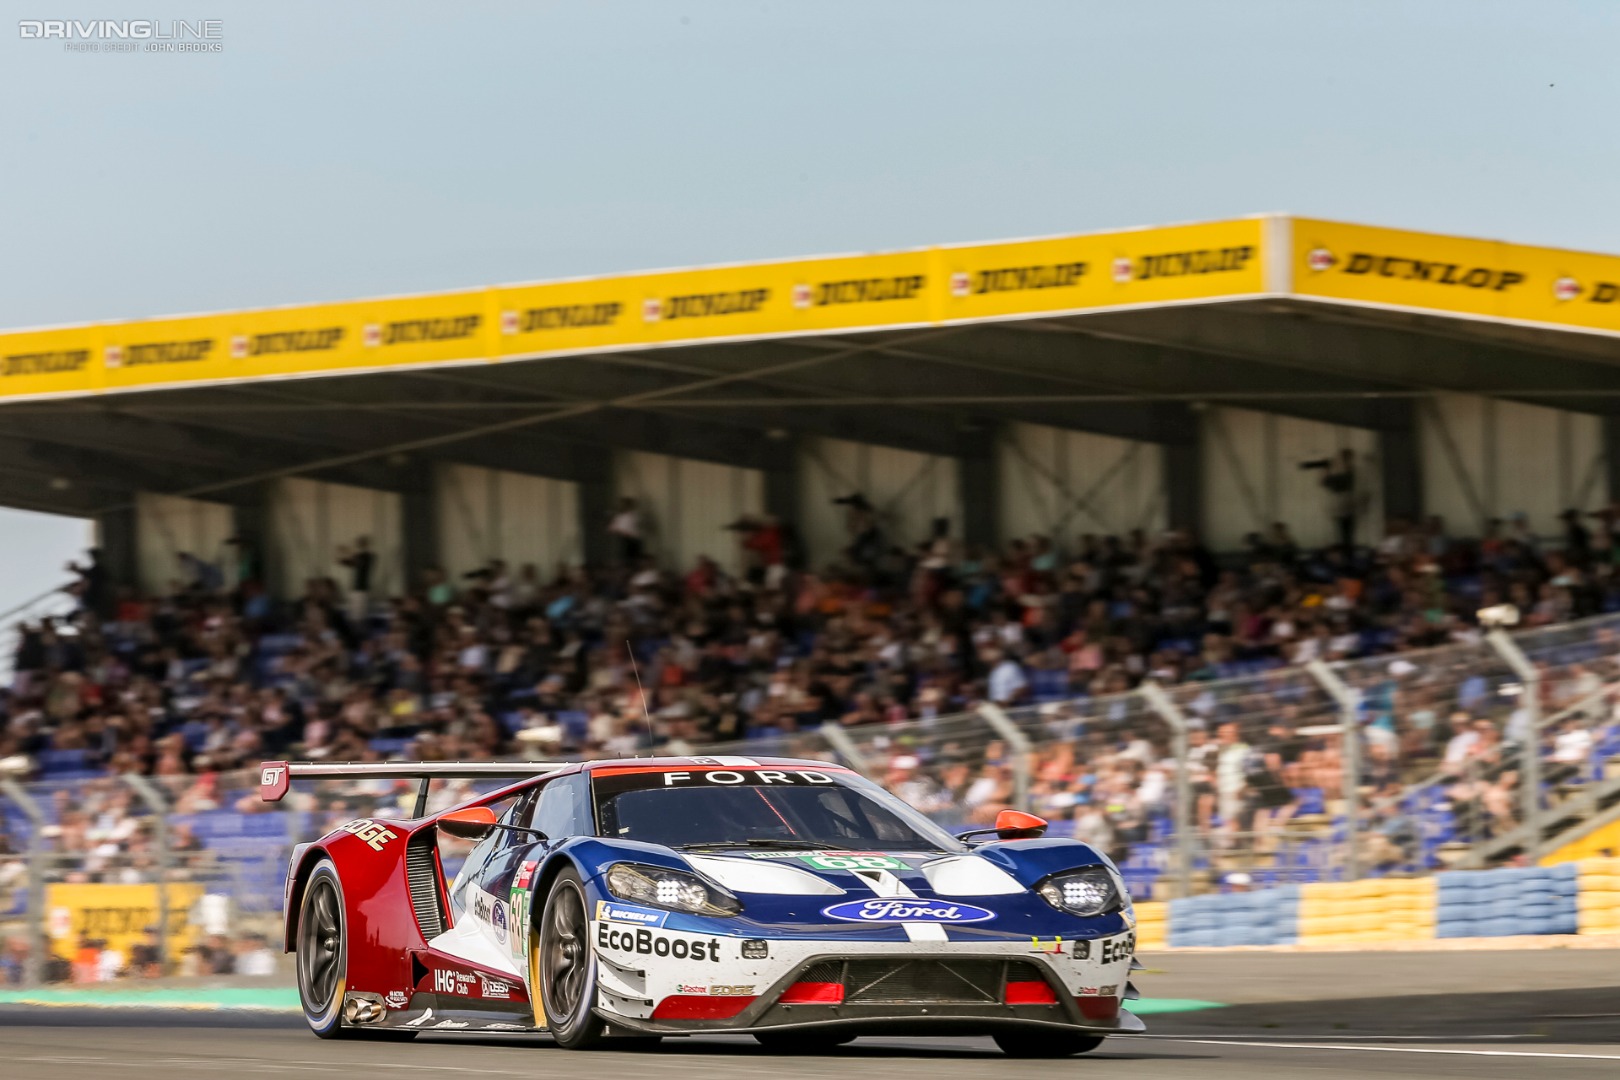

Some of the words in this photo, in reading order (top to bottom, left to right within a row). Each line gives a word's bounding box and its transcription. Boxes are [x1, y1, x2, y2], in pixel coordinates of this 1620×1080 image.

[1343, 252, 1526, 292] DUNLOP
[261, 767, 286, 787] GT
[664, 770, 834, 786] FORD
[811, 856, 899, 869] 68
[611, 909, 659, 922] MICHELIN
[859, 901, 962, 919] Ford
[510, 892, 523, 955] 68
[599, 922, 720, 962] EcoBoost
[434, 969, 456, 993] IHG
[456, 971, 477, 984] Rewards
[456, 983, 469, 995] Club
[683, 985, 707, 993] Castrol
[710, 985, 756, 995] EDGE
